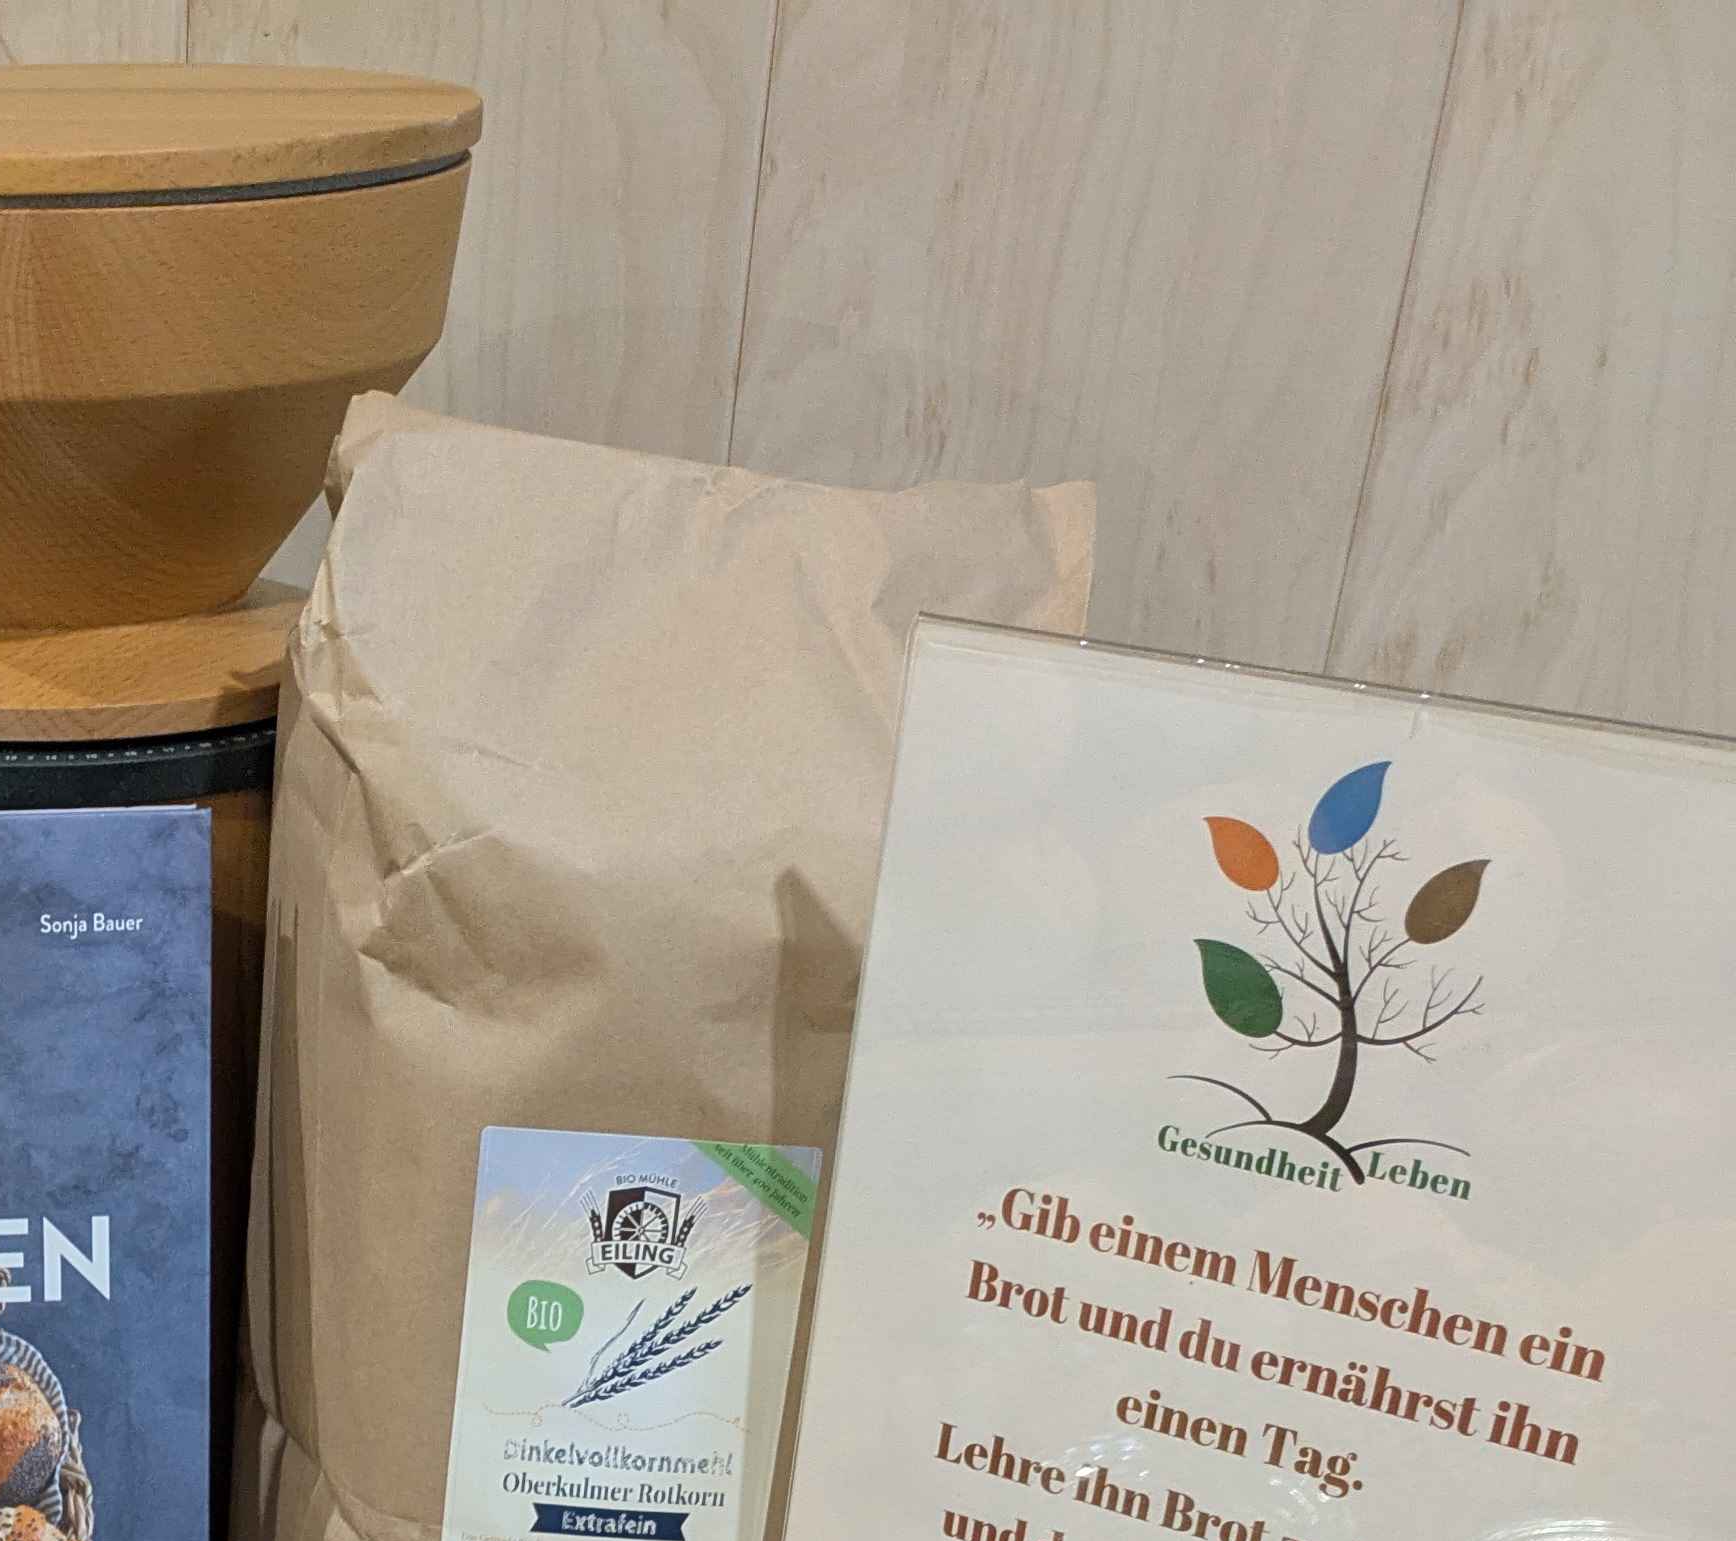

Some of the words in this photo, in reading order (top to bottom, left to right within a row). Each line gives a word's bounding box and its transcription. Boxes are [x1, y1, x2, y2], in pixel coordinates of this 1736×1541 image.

[40, 912, 88, 943] Sonja
[92, 911, 144, 933] Bauer
[1157, 1124, 1345, 1194] Gesundheit
[1365, 1151, 1472, 1200] Leben
[615, 1174, 636, 1186] BIO
[638, 1173, 678, 1189] MÜHLE
[601, 1244, 675, 1266] EILING
[978, 1186, 1081, 1244] „Gib
[1089, 1214, 1236, 1286] einem
[1246, 1250, 1508, 1356] Menschen
[1519, 1326, 1607, 1382] ein
[526, 1297, 563, 1332] BIO
[964, 1259, 1069, 1324] Brot
[1079, 1294, 1172, 1352] und
[1179, 1318, 1242, 1372] du
[1251, 1350, 1477, 1438] ernährst
[1488, 1401, 1581, 1466] ihn
[503, 1438, 733, 1476] Dinkelvollkornmehl
[1116, 1389, 1248, 1457] einen
[1262, 1423, 1364, 1499] Tag.
[502, 1471, 633, 1503] Oberkulmer
[638, 1482, 726, 1507] Rotkorn
[935, 1421, 1066, 1495] Lehre
[1072, 1463, 1151, 1521] ihn
[561, 1511, 657, 1536] Extrafein
